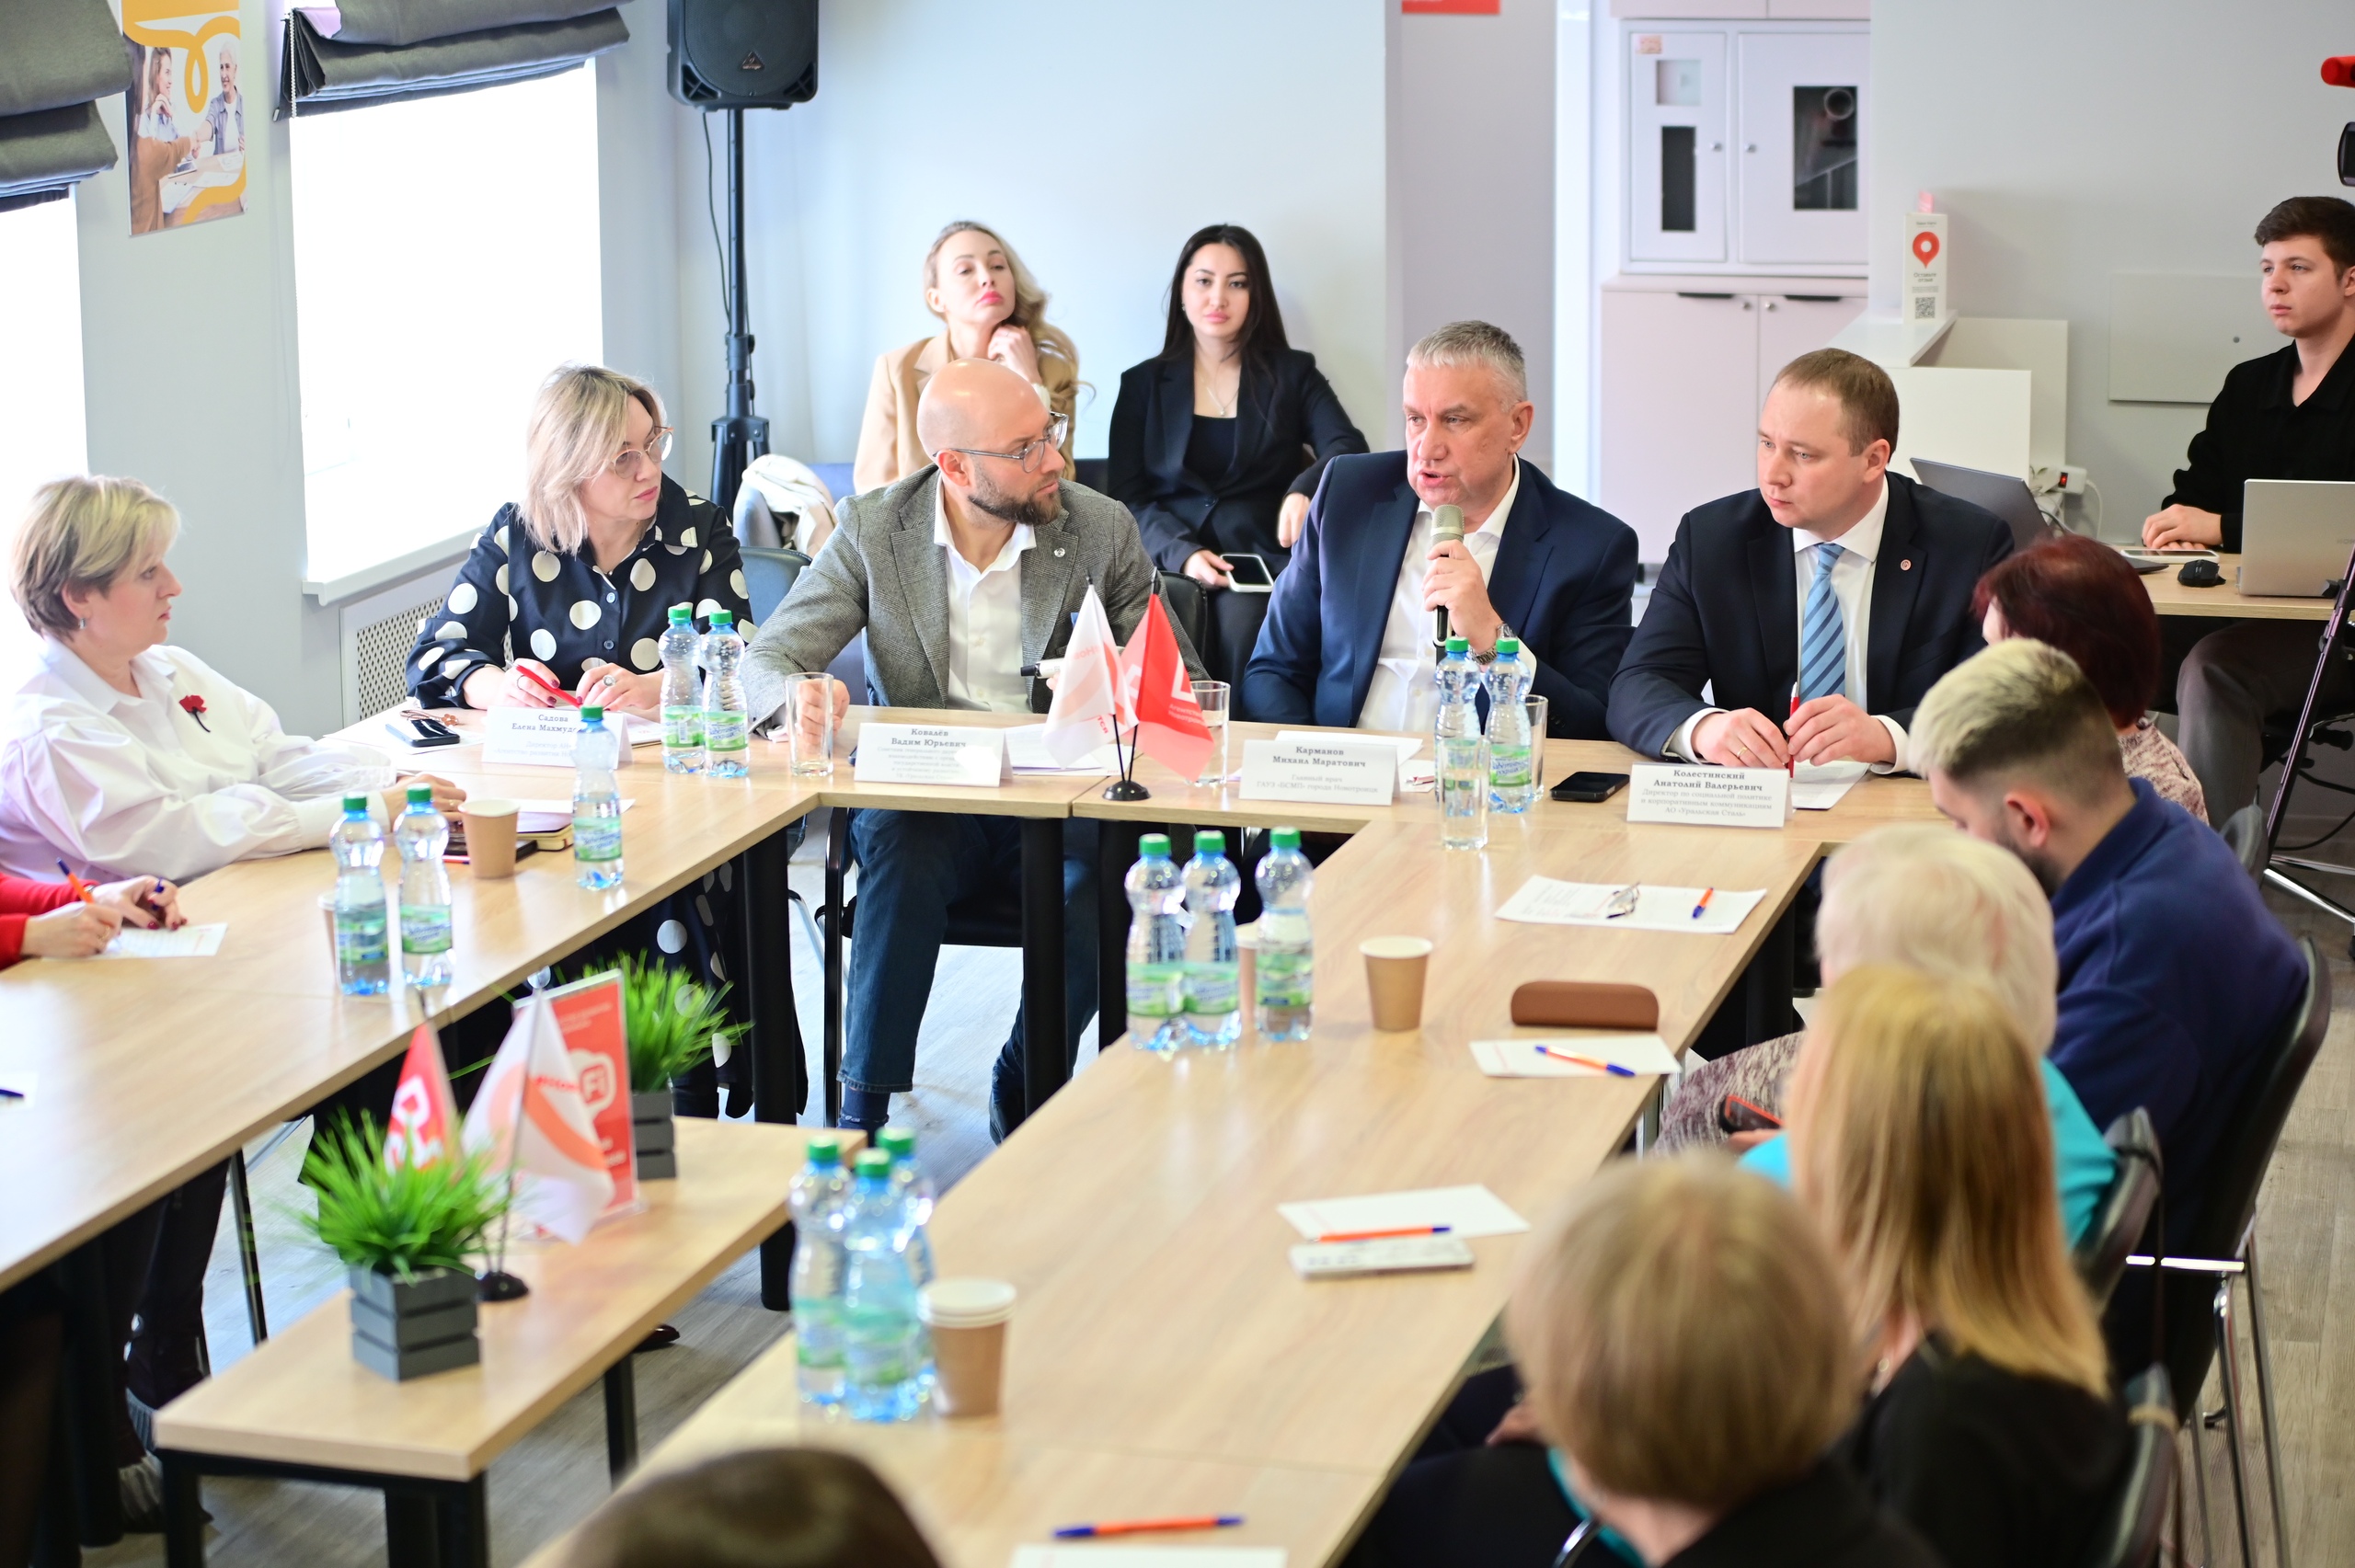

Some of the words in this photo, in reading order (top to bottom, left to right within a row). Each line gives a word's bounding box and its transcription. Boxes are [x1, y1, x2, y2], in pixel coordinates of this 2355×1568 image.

[538, 714, 569, 722] Садова
[511, 723, 536, 731] Елена
[911, 727, 949, 737] Ковалёв
[891, 738, 921, 747] Вадим
[924, 738, 967, 748] Юрьевич
[1295, 746, 1344, 756] Карманов
[1272, 755, 1309, 764] Михаил
[1312, 758, 1366, 767] Маратович
[1673, 769, 1745, 780] Колестинский
[1653, 779, 1701, 788] Анатолий
[1705, 781, 1763, 792] Валерьевич
[1642, 788, 1679, 797] Директор
[1691, 791, 1735, 799] социальной
[1648, 799, 1708, 807] корпоративным
[1710, 801, 1772, 810] коммуникациям
